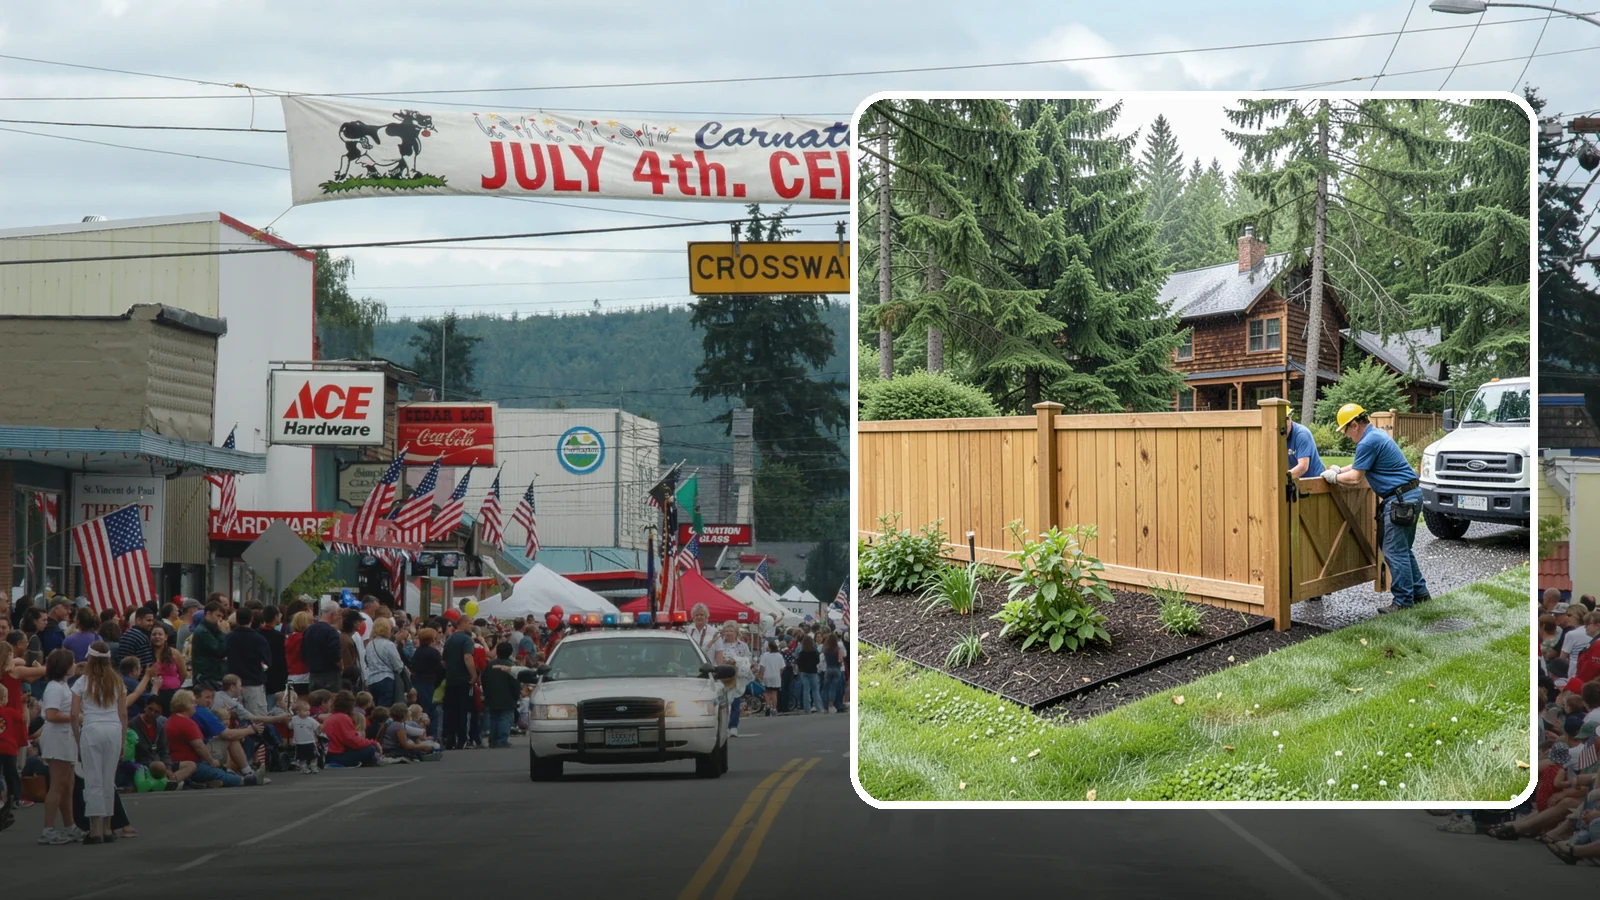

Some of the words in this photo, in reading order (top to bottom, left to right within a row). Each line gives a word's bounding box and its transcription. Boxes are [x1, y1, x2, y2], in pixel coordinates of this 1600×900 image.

[695, 121, 850, 150] Carnat
[481, 141, 605, 192] JULY
[632, 150, 746, 198] 4th.
[697, 254, 850, 280] CROSSWA
[283, 380, 373, 420] ACE
[406, 409, 452, 422] CEDAR
[283, 421, 370, 436] Hardware
[416, 428, 476, 446] Coca-Cola
[354, 467, 386, 482] Simpl
[83, 485, 94, 494] St.
[96, 486, 123, 494] Vincent
[126, 486, 135, 494] de
[138, 486, 155, 495] Paul
[688, 527, 741, 535] CRNATION
[699, 535, 730, 543] GLASS
